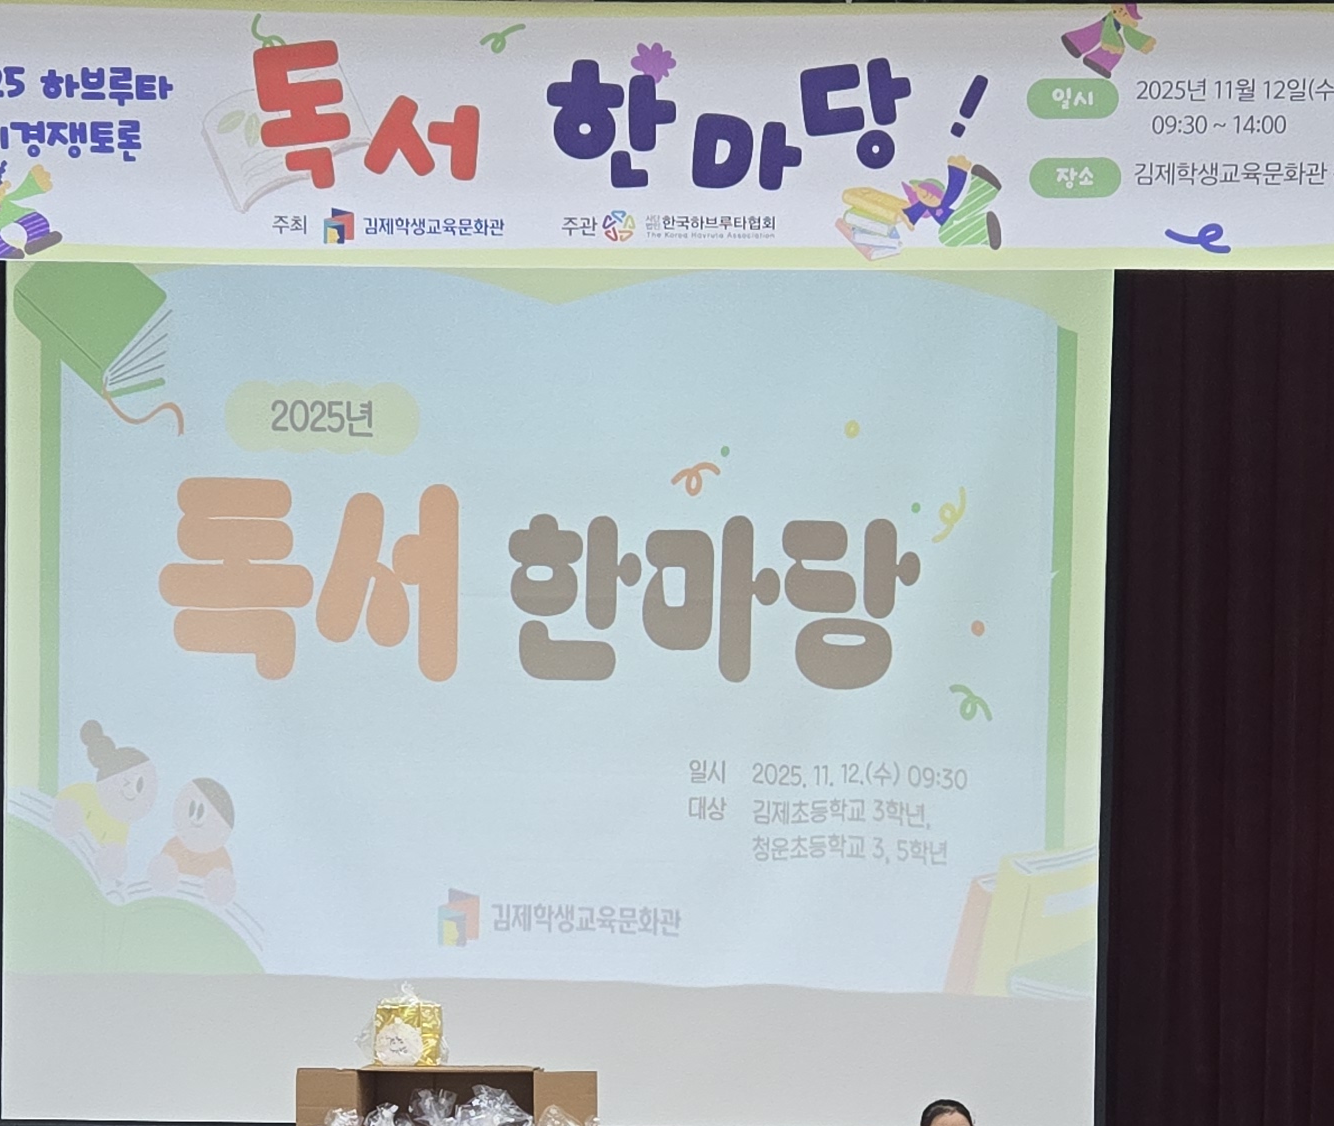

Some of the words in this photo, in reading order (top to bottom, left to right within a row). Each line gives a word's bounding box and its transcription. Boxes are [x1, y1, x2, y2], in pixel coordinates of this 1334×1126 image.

[40, 64, 174, 104] 하브루타
[1051, 86, 1095, 108] 일시
[1135, 76, 1207, 103] 2025년
[1213, 76, 1257, 103] 11월
[252, 39, 480, 189] 독서
[1151, 113, 1208, 137] 09:30
[1231, 113, 1288, 137] 14:00
[1054, 165, 1097, 188] 장소
[1133, 160, 1328, 189] 김제학생교육문화관
[272, 215, 307, 235] 주최
[364, 216, 505, 237] 김제학생교육문화관
[562, 215, 597, 237] 주관
[647, 231, 662, 239] The
[662, 214, 776, 231] 한국하브루타협회
[270, 398, 375, 439] 2025년
[158, 476, 460, 682] 독서
[508, 513, 921, 690] 한마당
[688, 760, 727, 785] 일시
[752, 762, 807, 788] 2025.
[814, 764, 835, 787] 11.
[907, 765, 969, 791] 09:30
[688, 797, 729, 822] 대상
[752, 798, 867, 826] 김제초등학교
[752, 835, 867, 863] 청운초등학교
[897, 839, 950, 867] 5학년
[492, 902, 683, 938] 김제학생교육문화관
